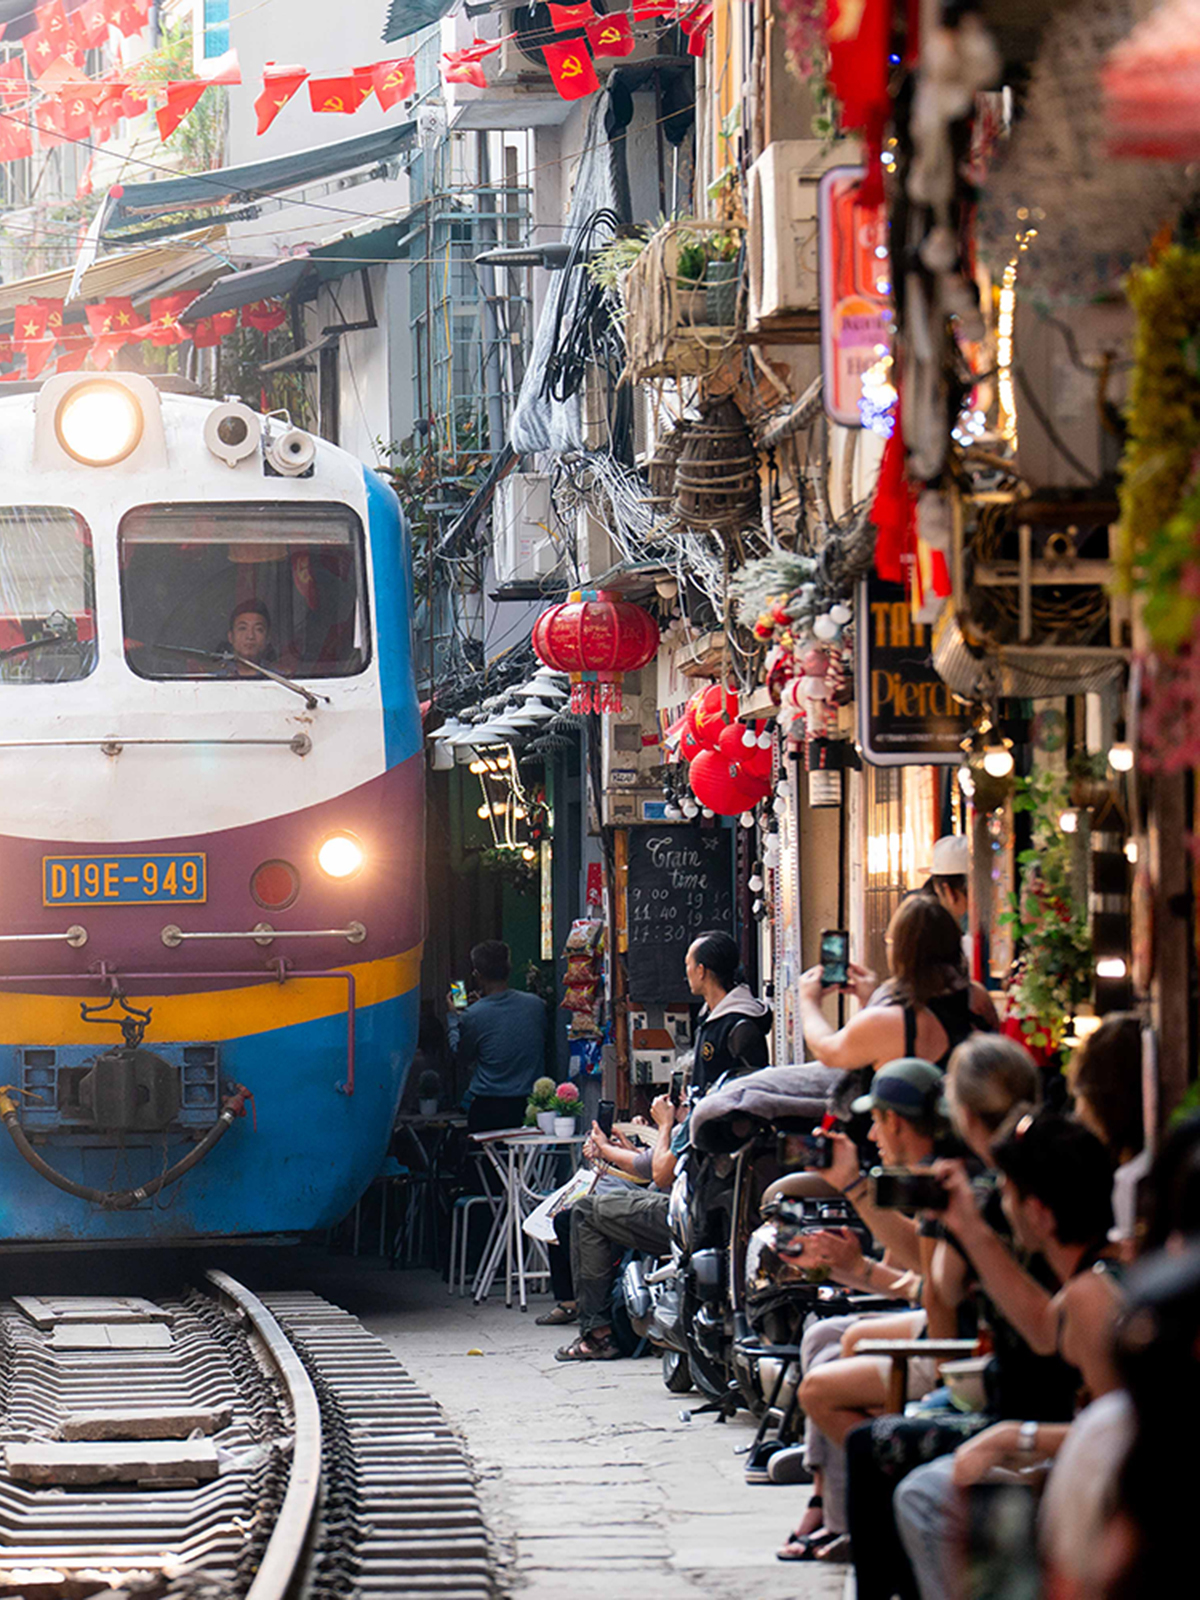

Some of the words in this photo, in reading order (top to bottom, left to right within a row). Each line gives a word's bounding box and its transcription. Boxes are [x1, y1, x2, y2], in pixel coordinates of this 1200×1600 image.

[646, 836, 702, 868] Train
[51, 861, 198, 899] D19E-949
[668, 868, 708, 890] time
